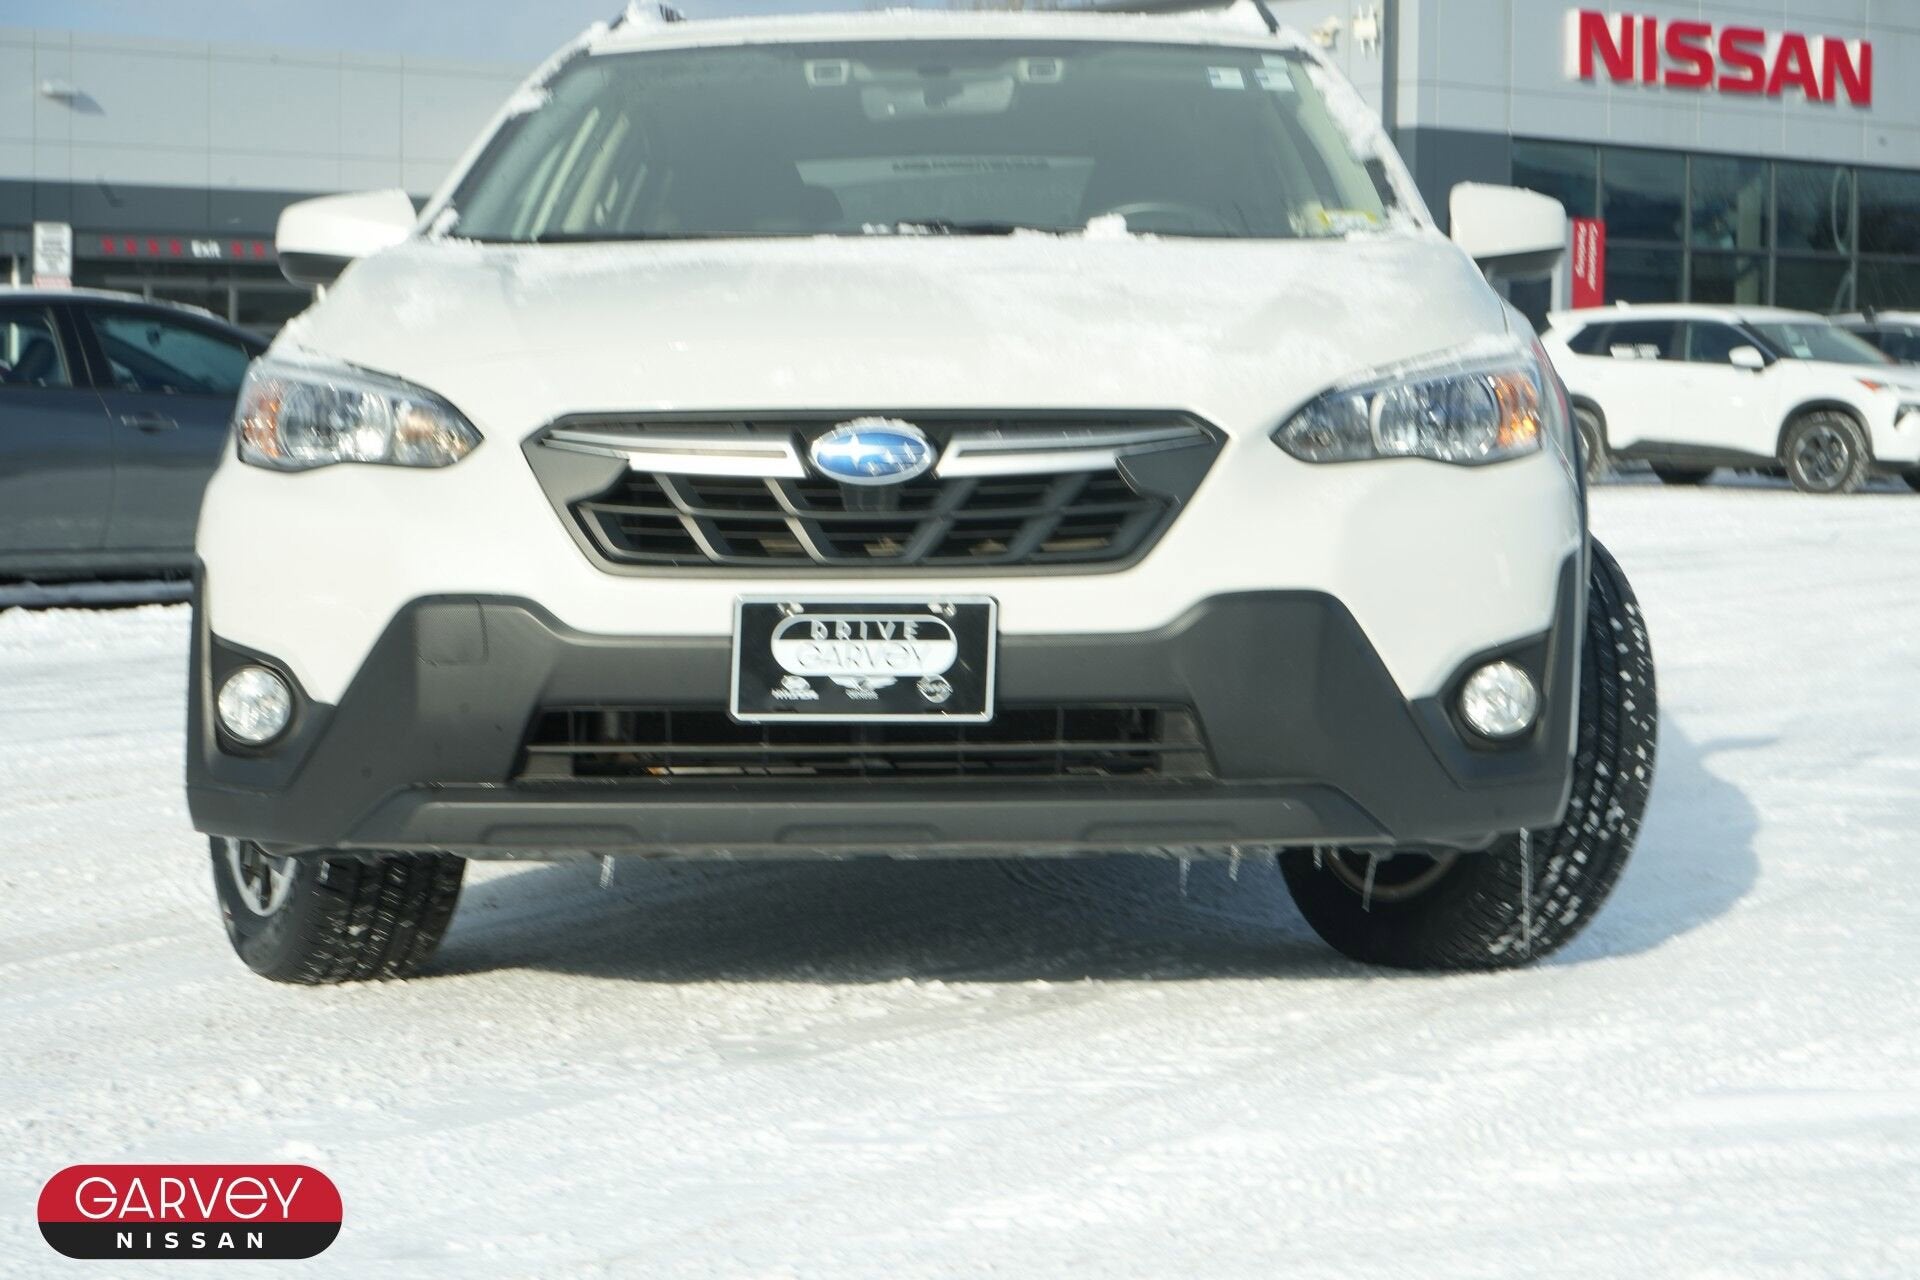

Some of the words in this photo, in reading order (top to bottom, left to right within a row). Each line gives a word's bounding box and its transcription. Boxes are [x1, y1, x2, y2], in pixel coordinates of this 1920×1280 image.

[1575, 9, 1873, 107] NISSAN
[191, 239, 222, 258] Exit
[810, 620, 920, 641] DRIVE
